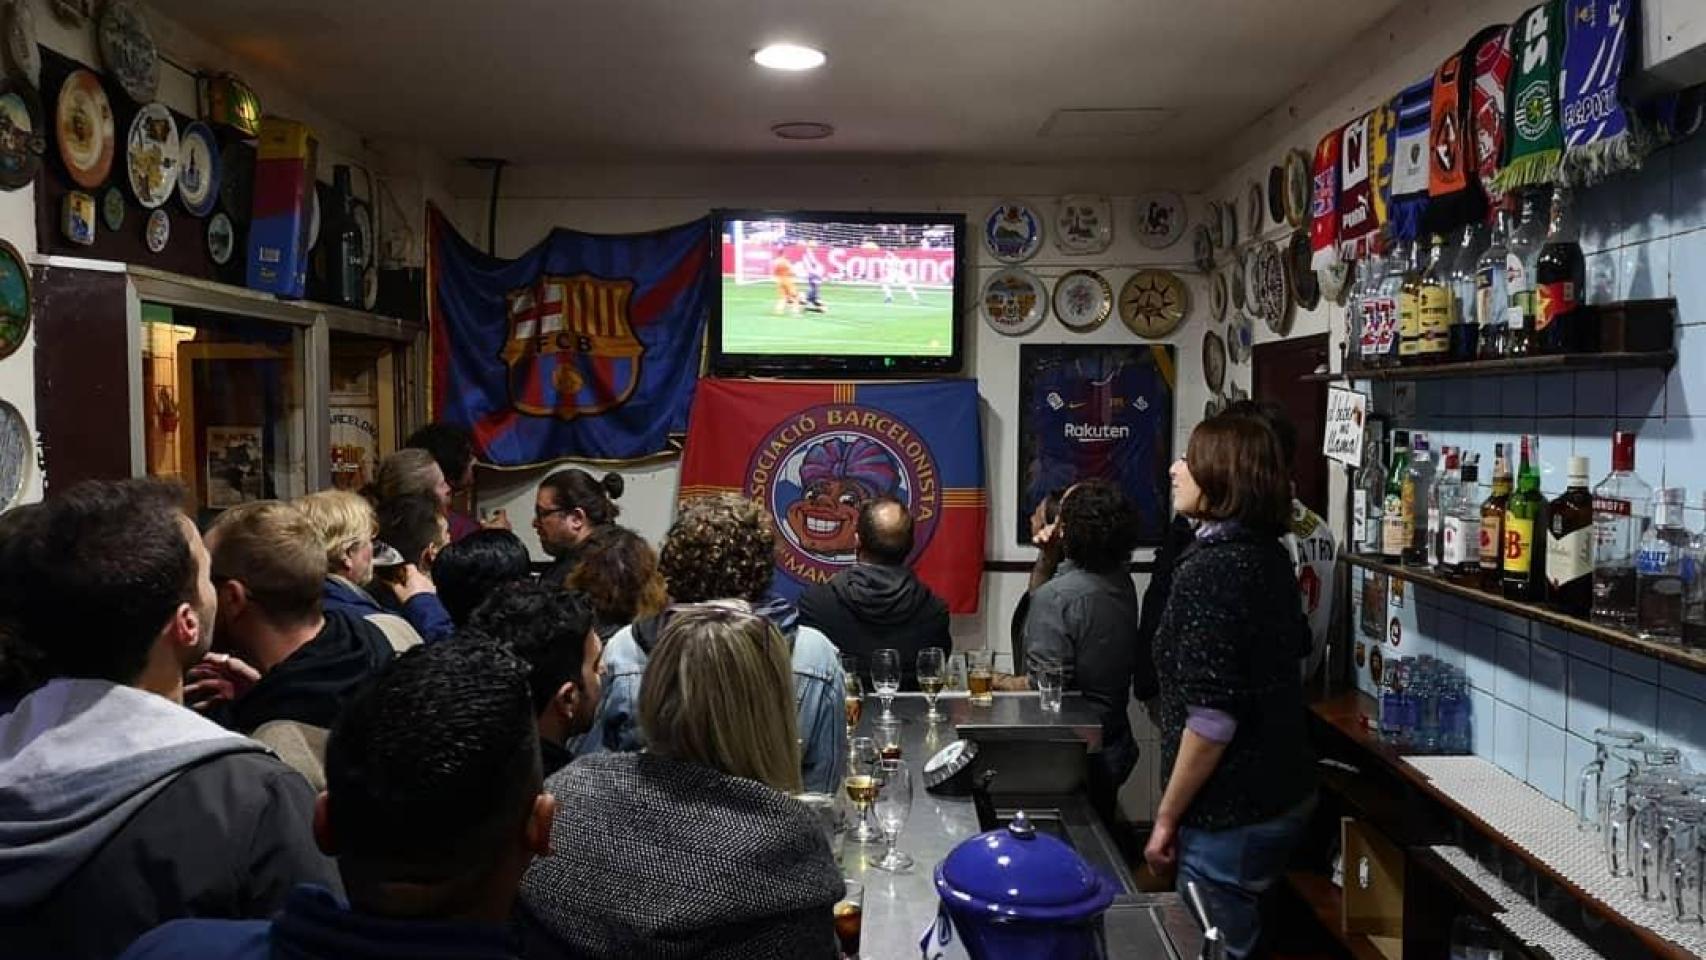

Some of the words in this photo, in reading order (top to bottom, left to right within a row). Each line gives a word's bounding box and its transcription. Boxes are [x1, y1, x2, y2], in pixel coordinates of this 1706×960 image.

[1064, 423, 1130, 438] Rakuten
[751, 414, 816, 512] SSOCIACIÓ
[827, 409, 936, 522] BARCELONISTA
